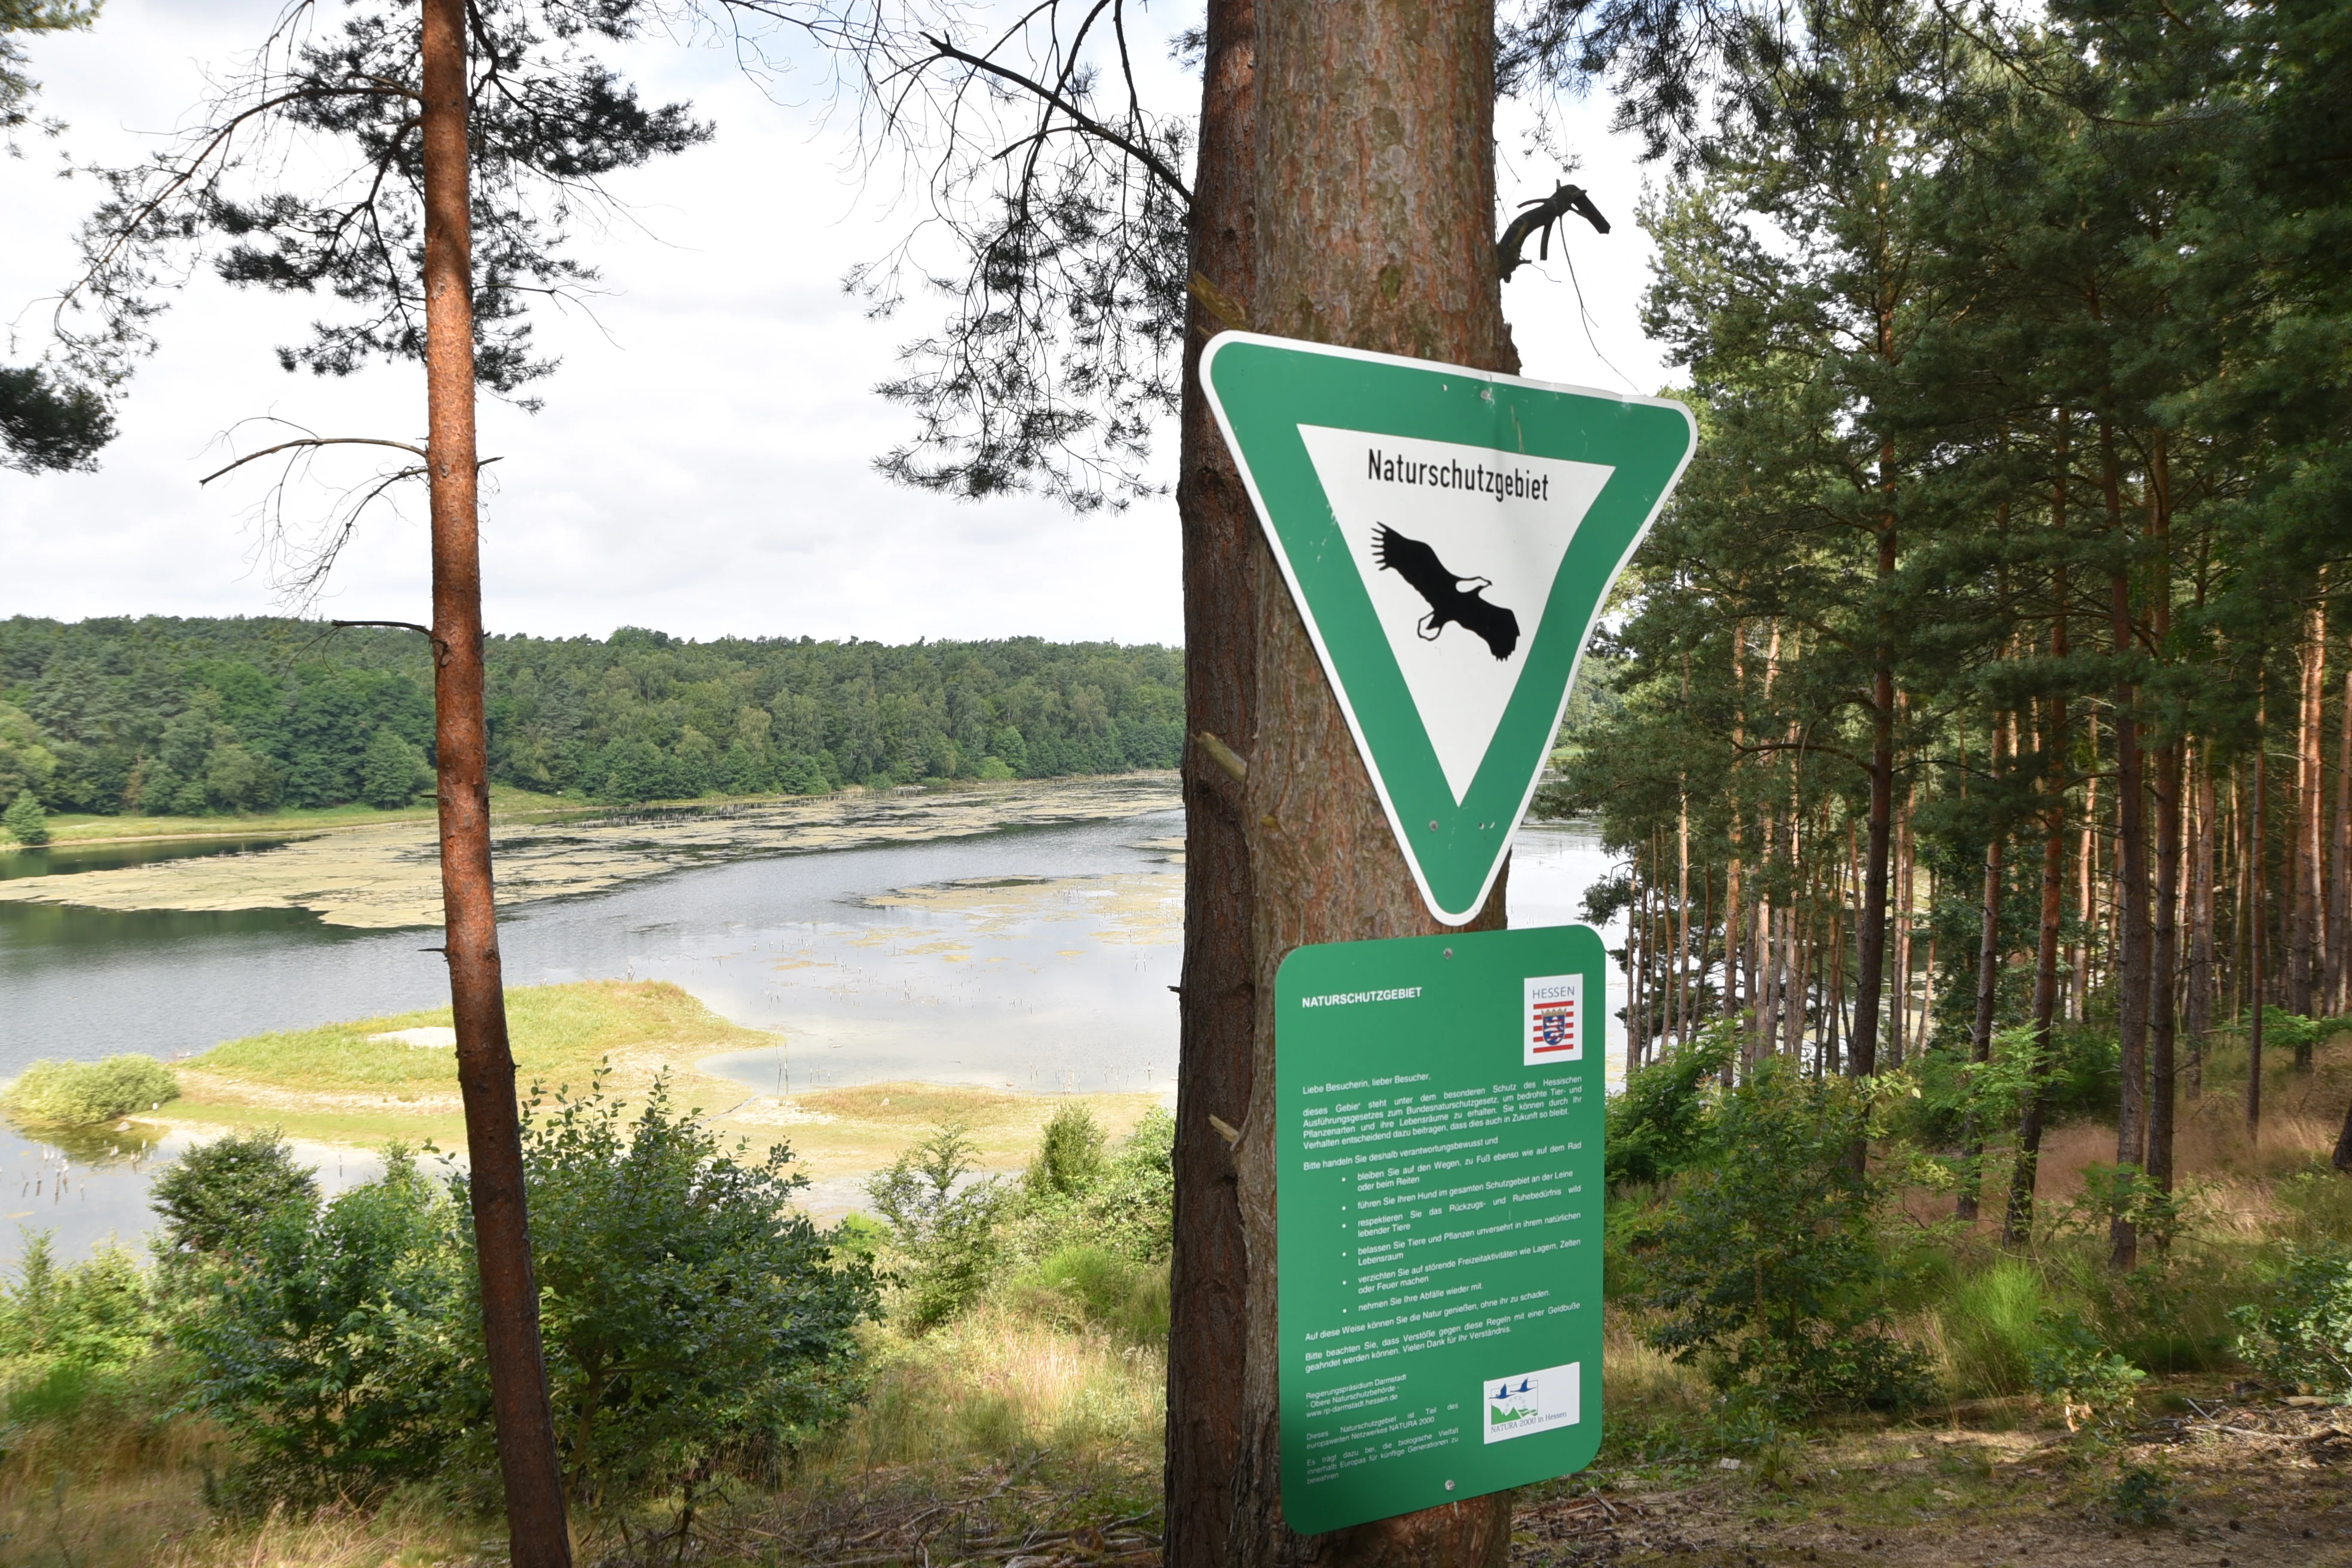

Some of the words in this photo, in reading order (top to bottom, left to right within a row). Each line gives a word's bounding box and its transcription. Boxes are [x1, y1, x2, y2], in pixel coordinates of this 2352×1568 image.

[1368, 448, 1548, 503] Naturschutzgebiet
[1301, 987, 1423, 1007] NATURSCHUTZGEBIET
[1533, 985, 1575, 1000] HESSEN
[1302, 1085, 1324, 1095] Liebe
[1325, 1080, 1370, 1092] Besucherin,
[1371, 1077, 1393, 1086] lieber
[1394, 1073, 1431, 1084] Besucher,
[1302, 1107, 1328, 1116] dieses
[1368, 1099, 1387, 1108] steht
[1394, 1097, 1413, 1105] unter
[1420, 1094, 1437, 1102] dem
[1443, 1088, 1486, 1099] besonderen
[1493, 1083, 1517, 1093] Schutz
[1523, 1081, 1536, 1089] des
[1543, 1076, 1582, 1086] Hessischen
[1303, 1111, 1384, 1128] Ausführungsgesetzes
[1387, 1108, 1403, 1117] zum
[1406, 1097, 1499, 1115] Bundesnaturschutzgesetz,
[1517, 1090, 1547, 1101] bedrohte
[1569, 1085, 1582, 1094] und
[1303, 1126, 1355, 1138] Pflanzenarten
[1361, 1122, 1376, 1131] und
[1380, 1120, 1395, 1129] ihre
[1399, 1114, 1449, 1126] Lebensräume
[1467, 1107, 1496, 1117] erhalten.
[1502, 1104, 1514, 1113] Sie
[1519, 1101, 1545, 1110] können
[1548, 1097, 1569, 1107] durch
[1303, 1139, 1340, 1149] Verhalten
[1341, 1131, 1392, 1144] entscheidend
[1412, 1125, 1448, 1136] beitragen,
[1450, 1122, 1468, 1131] dass
[1468, 1120, 1484, 1128] dies
[1485, 1116, 1503, 1126] auch
[1511, 1111, 1538, 1122] Zukunft
[1549, 1107, 1569, 1117] bleibt.
[1303, 1161, 1321, 1171] Bitte
[1322, 1156, 1353, 1168] handeln
[1354, 1154, 1368, 1163] Sie
[1368, 1150, 1398, 1162] deshalb
[1399, 1138, 1483, 1157] verantwortungsbewusst
[1484, 1136, 1499, 1146] und
[1357, 1171, 1385, 1181] bleiben
[1388, 1167, 1400, 1177] Sie
[1402, 1165, 1415, 1174] auf
[1417, 1163, 1432, 1172] den
[1434, 1160, 1462, 1170] Wegen,
[1476, 1153, 1491, 1163] Fuß
[1493, 1151, 1520, 1162] ebenso
[1521, 1149, 1534, 1157] wie
[1536, 1146, 1548, 1155] auf
[1549, 1144, 1565, 1153] dem
[1567, 1141, 1582, 1150] Rad
[1357, 1183, 1374, 1192] oder
[1376, 1180, 1395, 1189] beim
[1396, 1176, 1420, 1186] Reiten
[1357, 1199, 1382, 1209] führen
[1383, 1196, 1396, 1205] Sie
[1397, 1194, 1416, 1203] Ihren
[1417, 1190, 1438, 1200] Hund
[1448, 1184, 1484, 1197] gesamten
[1485, 1176, 1530, 1190] Schutzgebiet
[1541, 1173, 1554, 1181] der
[1554, 1170, 1573, 1180] Leine
[1358, 1214, 1403, 1227] respektieren
[1410, 1209, 1422, 1219] Sie
[1428, 1207, 1443, 1216] das
[1449, 1200, 1486, 1213] Rückzugs-
[1493, 1196, 1506, 1206] und
[1512, 1189, 1562, 1202] Ruhebedürfnis
[1567, 1184, 1582, 1194] wild
[1358, 1227, 1391, 1238] lebender
[1392, 1223, 1411, 1232] Tiere
[1358, 1244, 1391, 1255] belassen
[1393, 1241, 1405, 1249] Sie
[1407, 1238, 1426, 1247] Tiere
[1428, 1233, 1443, 1244] und
[1444, 1230, 1475, 1241] Pflanzen
[1477, 1223, 1513, 1236] unversehrt
[1523, 1218, 1543, 1227] ihrem
[1544, 1212, 1581, 1224] natürlichen
[1358, 1252, 1404, 1266] Lebensraum
[1358, 1271, 1396, 1283] verzichten
[1397, 1268, 1410, 1276] Sie
[1411, 1264, 1423, 1274] auf
[1425, 1260, 1456, 1272] störende
[1457, 1250, 1518, 1266] Freizeitaktivitäten
[1519, 1247, 1532, 1255] wie
[1532, 1243, 1558, 1254] Lagern,
[1560, 1239, 1581, 1249] Zelten
[1358, 1285, 1375, 1294] oder
[1377, 1281, 1399, 1291] Feuer
[1399, 1276, 1429, 1287] machen
[1358, 1300, 1389, 1312] nehmen
[1389, 1297, 1402, 1306] Sie
[1404, 1295, 1419, 1303] Ihre
[1419, 1290, 1445, 1301] Abfälle
[1446, 1285, 1470, 1296] wieder
[1471, 1282, 1483, 1291] mit.
[1304, 1331, 1318, 1341] Auf
[1319, 1328, 1341, 1339] diese
[1342, 1324, 1366, 1334] Weise
[1367, 1319, 1395, 1330] können
[1396, 1315, 1408, 1324] Sie
[1409, 1313, 1421, 1322] die
[1422, 1310, 1443, 1319] Natur
[1444, 1303, 1479, 1317] genießen,
[1480, 1299, 1498, 1309] ohne
[1499, 1297, 1509, 1305] ihr
[1520, 1290, 1549, 1301] schaden.
[1305, 1352, 1323, 1361] Bitte
[1326, 1345, 1361, 1357] beachten
[1364, 1341, 1378, 1350] Sie,
[1382, 1337, 1399, 1346] dass
[1402, 1330, 1436, 1342] Verstöße
[1438, 1325, 1461, 1337] gegen
[1464, 1321, 1483, 1331] diese
[1486, 1315, 1511, 1326] Regeln
[1514, 1312, 1525, 1321] mit
[1527, 1309, 1545, 1319] einer
[1548, 1302, 1581, 1315] Geldbuße
[1305, 1359, 1341, 1373] geahndet
[1342, 1353, 1370, 1365] werden
[1371, 1348, 1400, 1359] können.
[1402, 1343, 1425, 1353] Vielen
[1426, 1339, 1446, 1349] Dank
[1458, 1334, 1468, 1342] Ihr
[1469, 1326, 1511, 1340] Verständnis.
[1306, 1381, 1374, 1399] Regierungspräsidium
[1374, 1373, 1407, 1386] Darmstadt
[1310, 1399, 1331, 1408] Obere
[1332, 1385, 1396, 1403] Naturschutzbehörde
[1490, 1422, 1518, 1434] NATURA
[1519, 1417, 1536, 1427] 2000
[1545, 1411, 1567, 1422] Hessen
